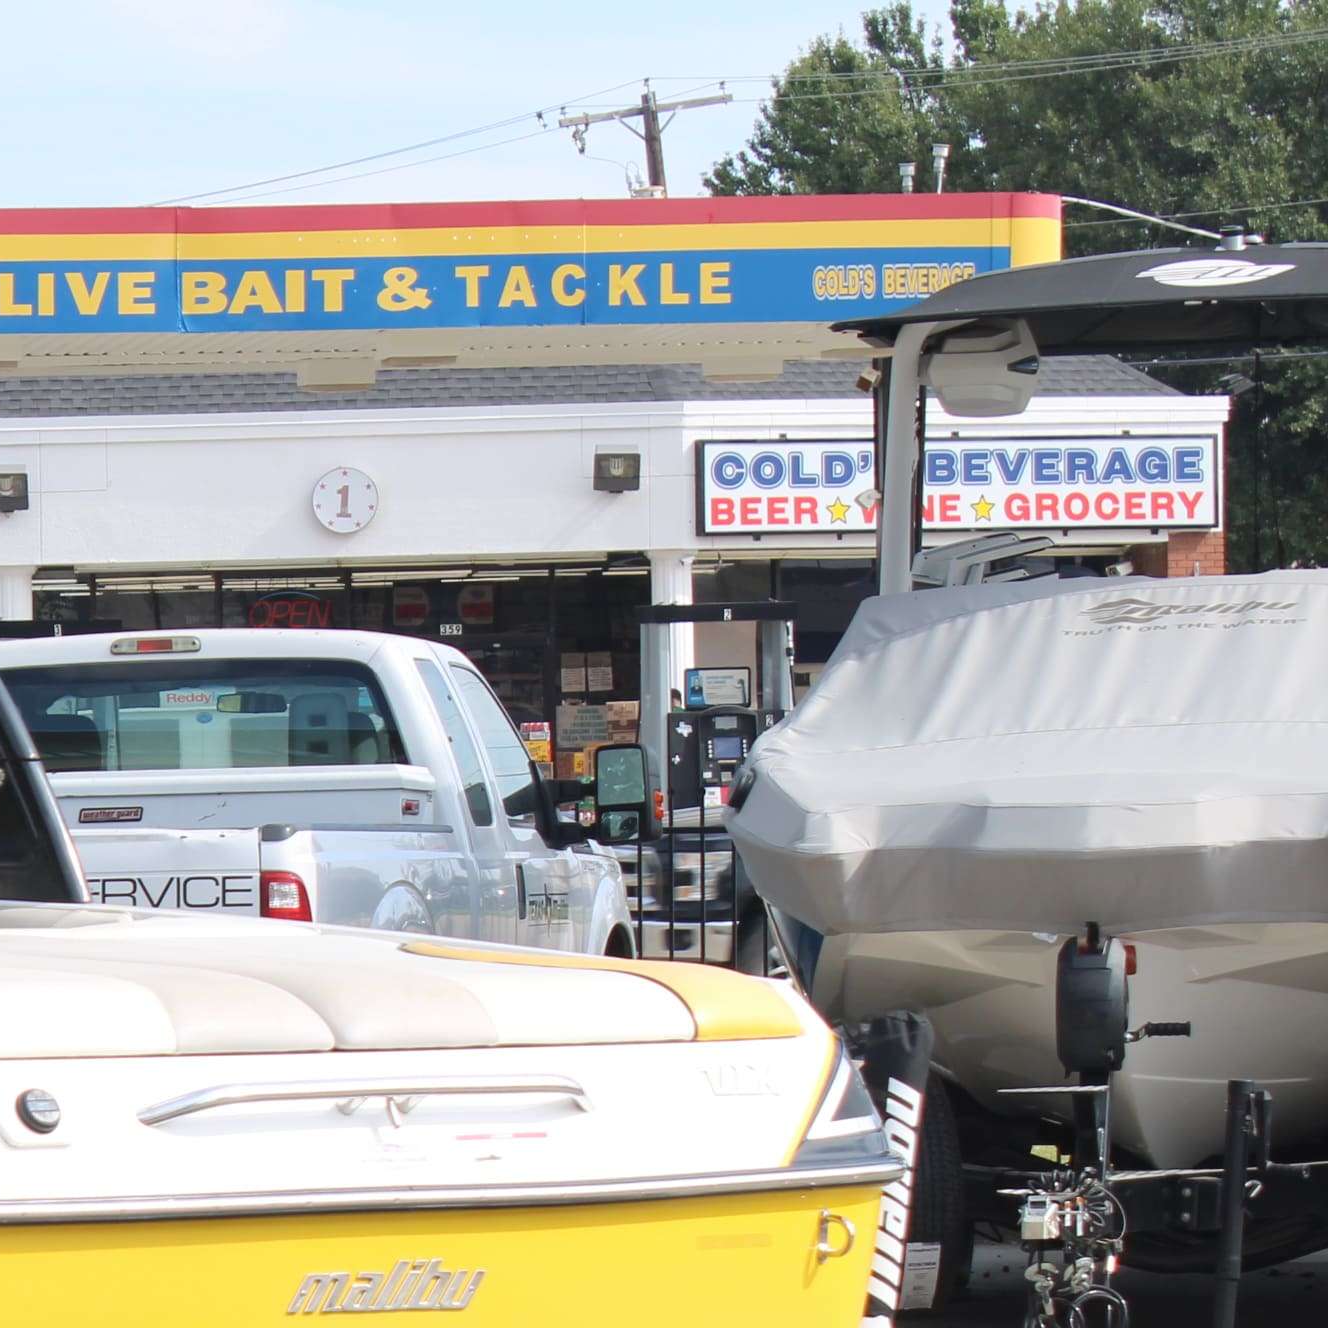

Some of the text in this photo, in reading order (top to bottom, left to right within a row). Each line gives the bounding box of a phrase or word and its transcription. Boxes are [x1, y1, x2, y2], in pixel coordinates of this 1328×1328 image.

[181, 268, 355, 315] BAIT
[376, 266, 432, 311] &
[455, 261, 732, 308] TACKLE
[813, 265, 876, 301] COLD'S
[710, 447, 1205, 489] COLD' BEVERAGE
[336, 484, 352, 518] 1
[710, 496, 819, 526] BEER
[1003, 491, 1205, 522] GROCERY
[249, 599, 332, 628] OPEN
[441, 624, 462, 635] 359
[1061, 624, 1132, 637] TRUTH
[1138, 624, 1168, 632] ON
[165, 692, 213, 706] Reddy
[82, 809, 140, 821] weather guard
[86, 875, 253, 909] RVICE
[285, 1257, 488, 1315] malibu
